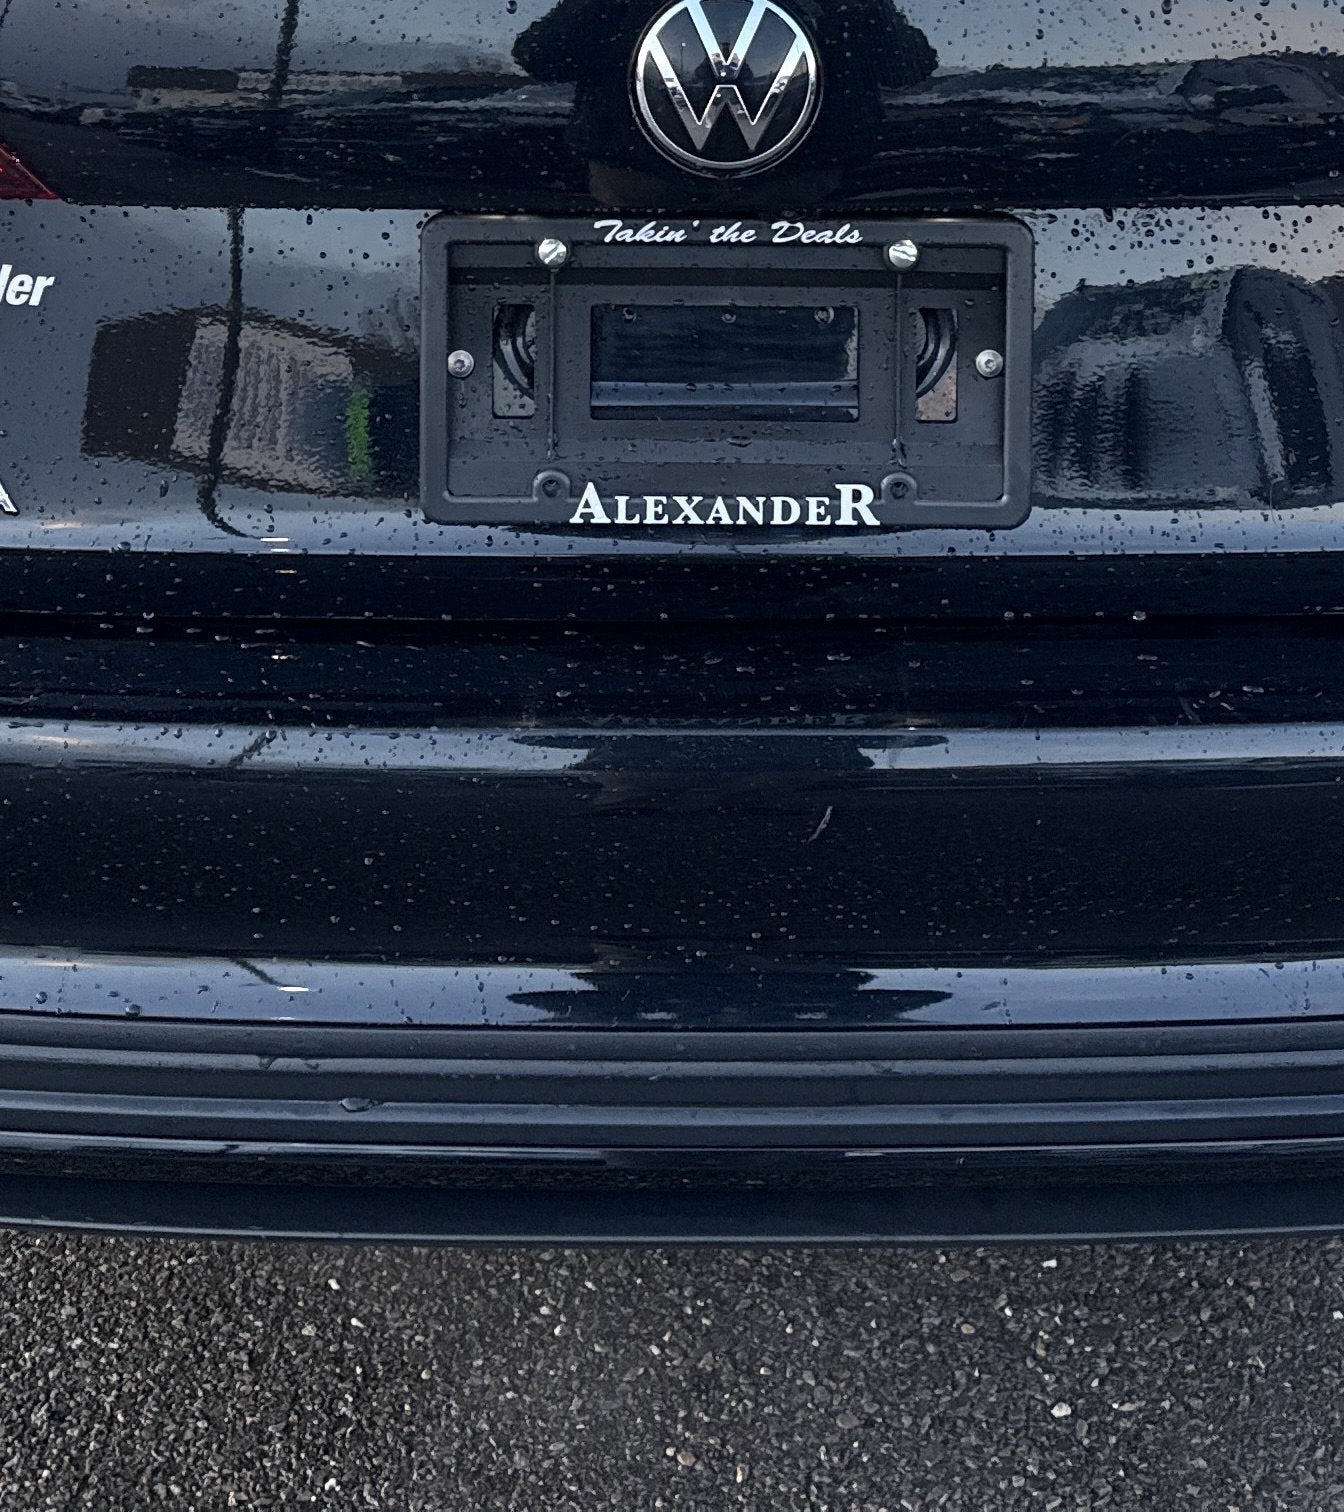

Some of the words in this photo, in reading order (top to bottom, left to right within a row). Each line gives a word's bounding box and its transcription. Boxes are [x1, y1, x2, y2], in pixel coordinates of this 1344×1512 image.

[593, 219, 701, 244] Takin'
[710, 219, 757, 244] the
[770, 220, 864, 245] Deals
[568, 482, 882, 527] ALEXANDER
